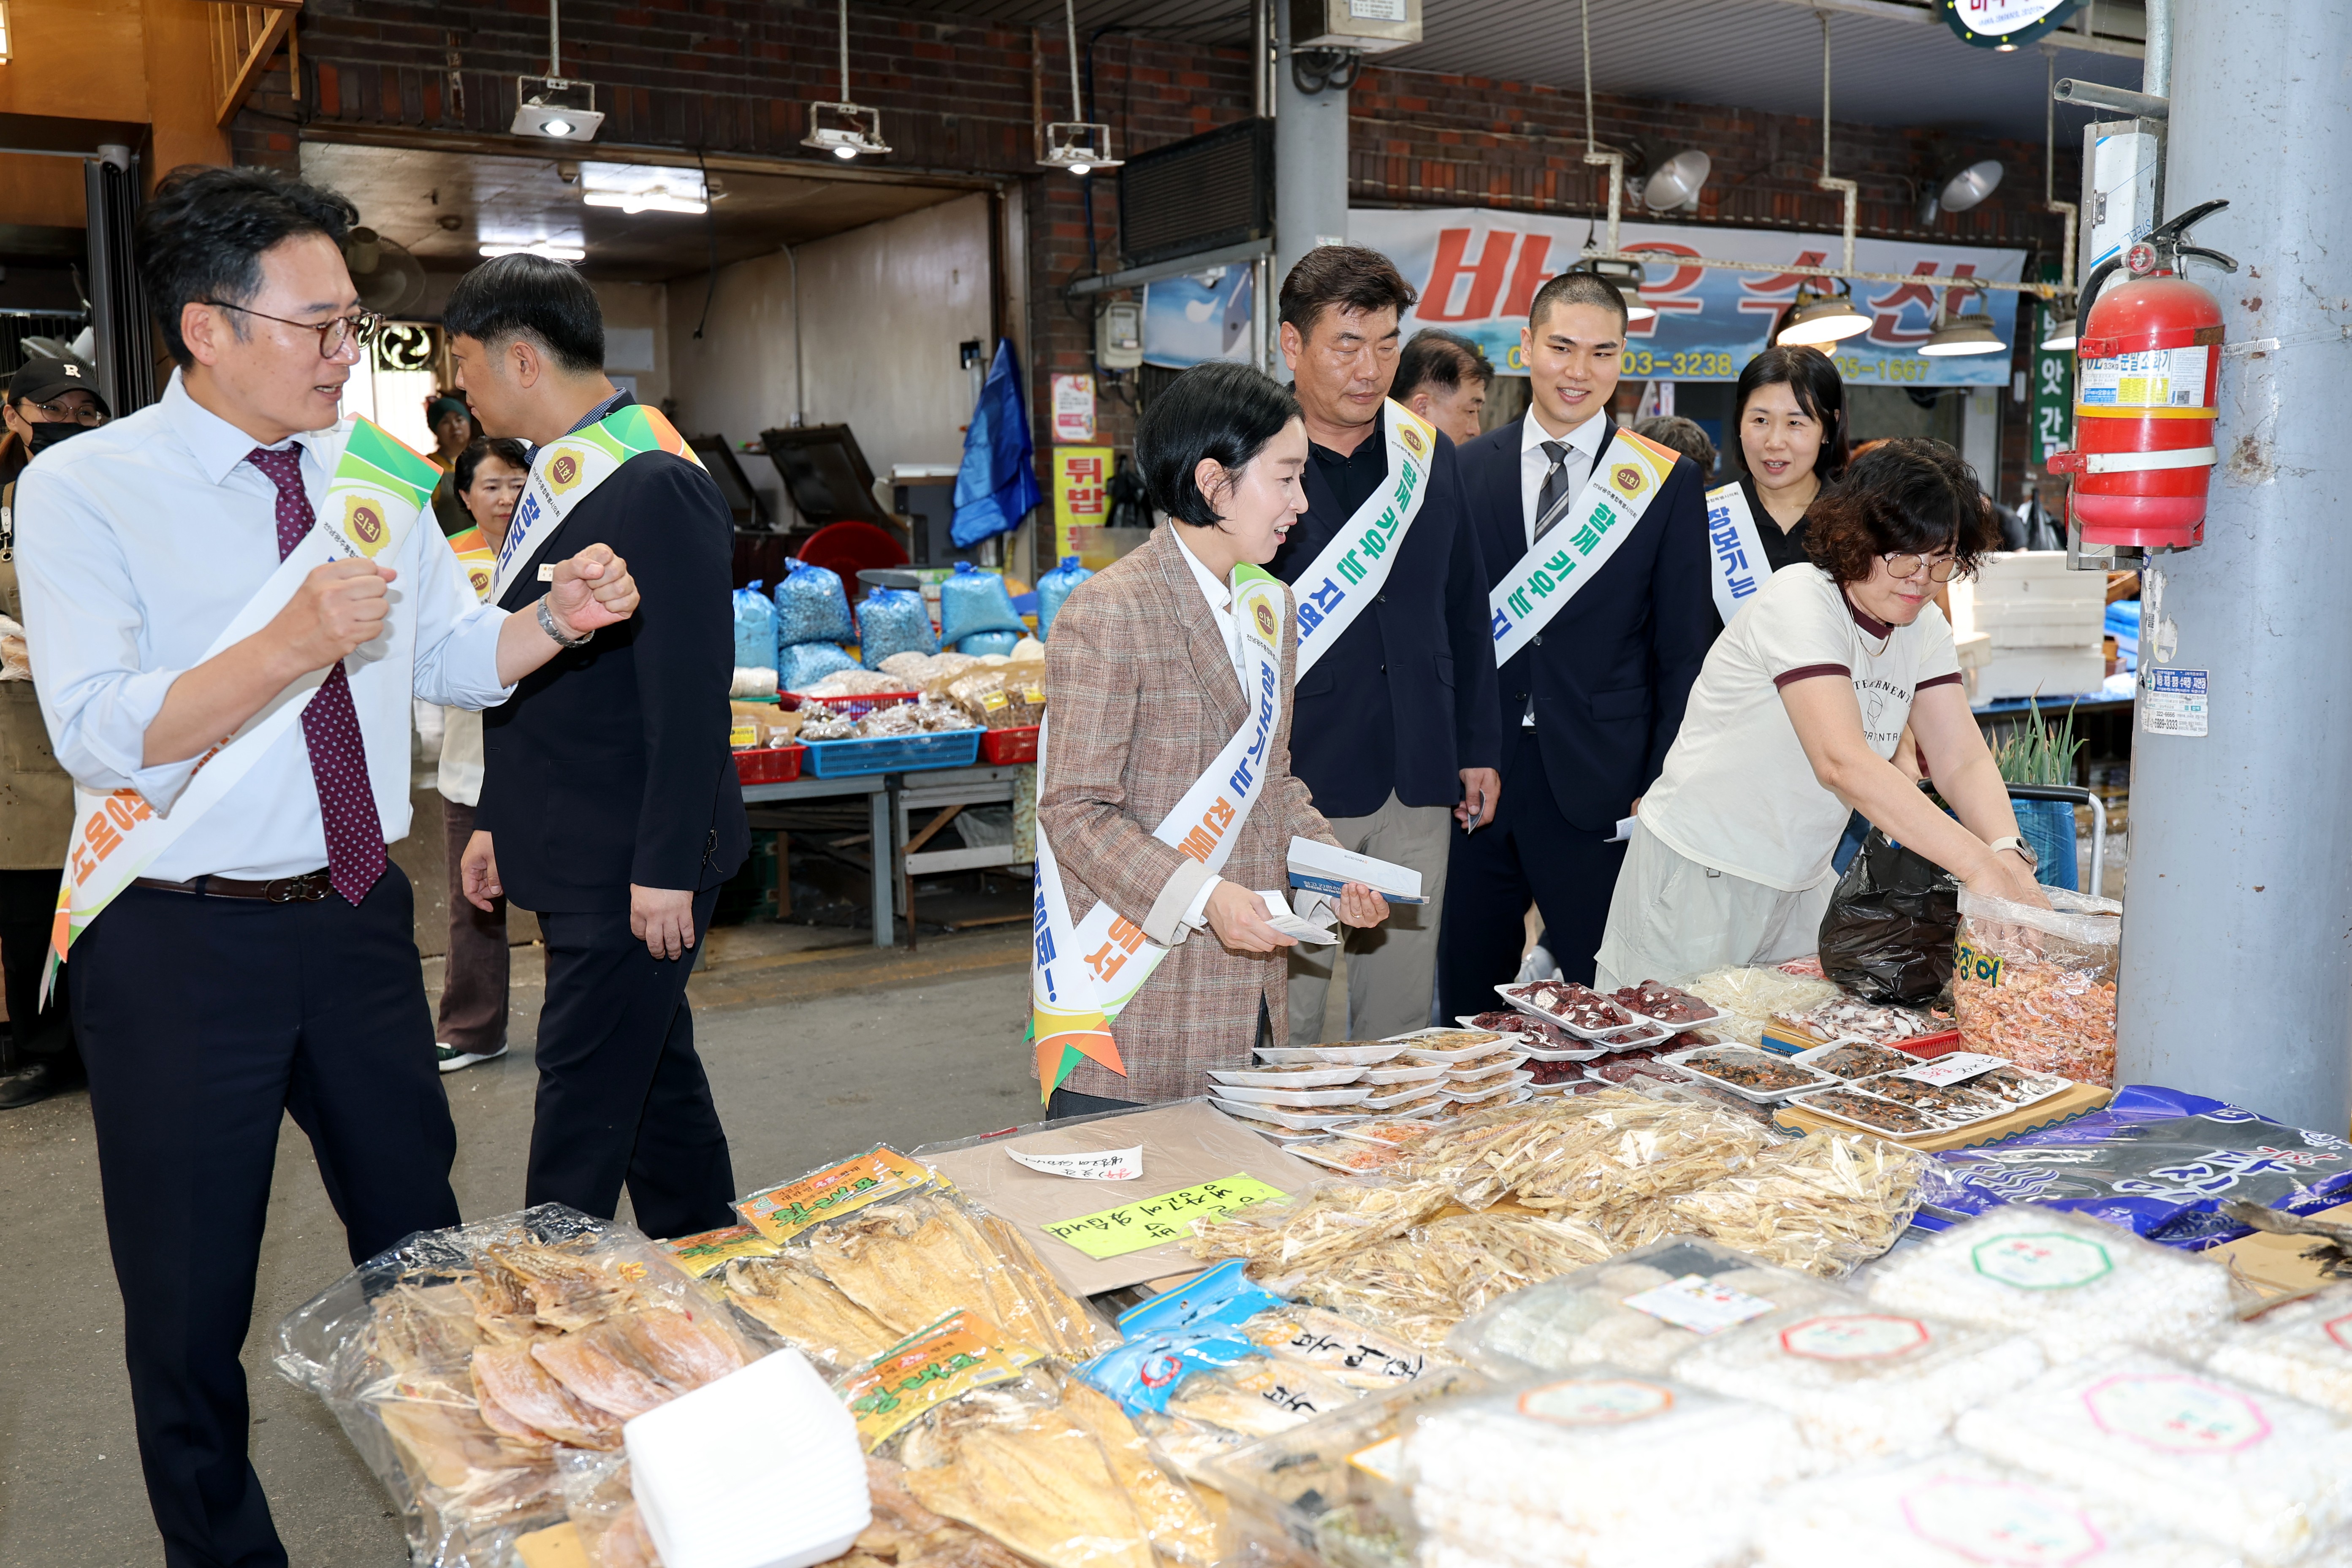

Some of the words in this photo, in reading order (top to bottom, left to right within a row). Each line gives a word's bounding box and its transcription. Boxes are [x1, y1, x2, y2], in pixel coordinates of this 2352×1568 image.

[2121, 219, 2151, 243] STEEL
[63, 364, 82, 378] R
[1404, 429, 1422, 450] 의회
[555, 460, 574, 482] 의회
[1394, 458, 1418, 513] 함께
[1617, 472, 1640, 490] 의회
[354, 512, 380, 540] 의회
[1570, 502, 1617, 556] 함께
[493, 491, 541, 594] 장보기는
[1336, 505, 1399, 585] 키우는
[1708, 507, 1757, 600] 장보기는
[1507, 550, 1576, 619] 키우는
[1259, 612, 1273, 631] 의회
[1229, 660, 1275, 799] 장보기는
[781, 1186, 813, 1202] 대관령
[815, 1176, 838, 1188] 名家
[1050, 1209, 1132, 1239] 있습니다
